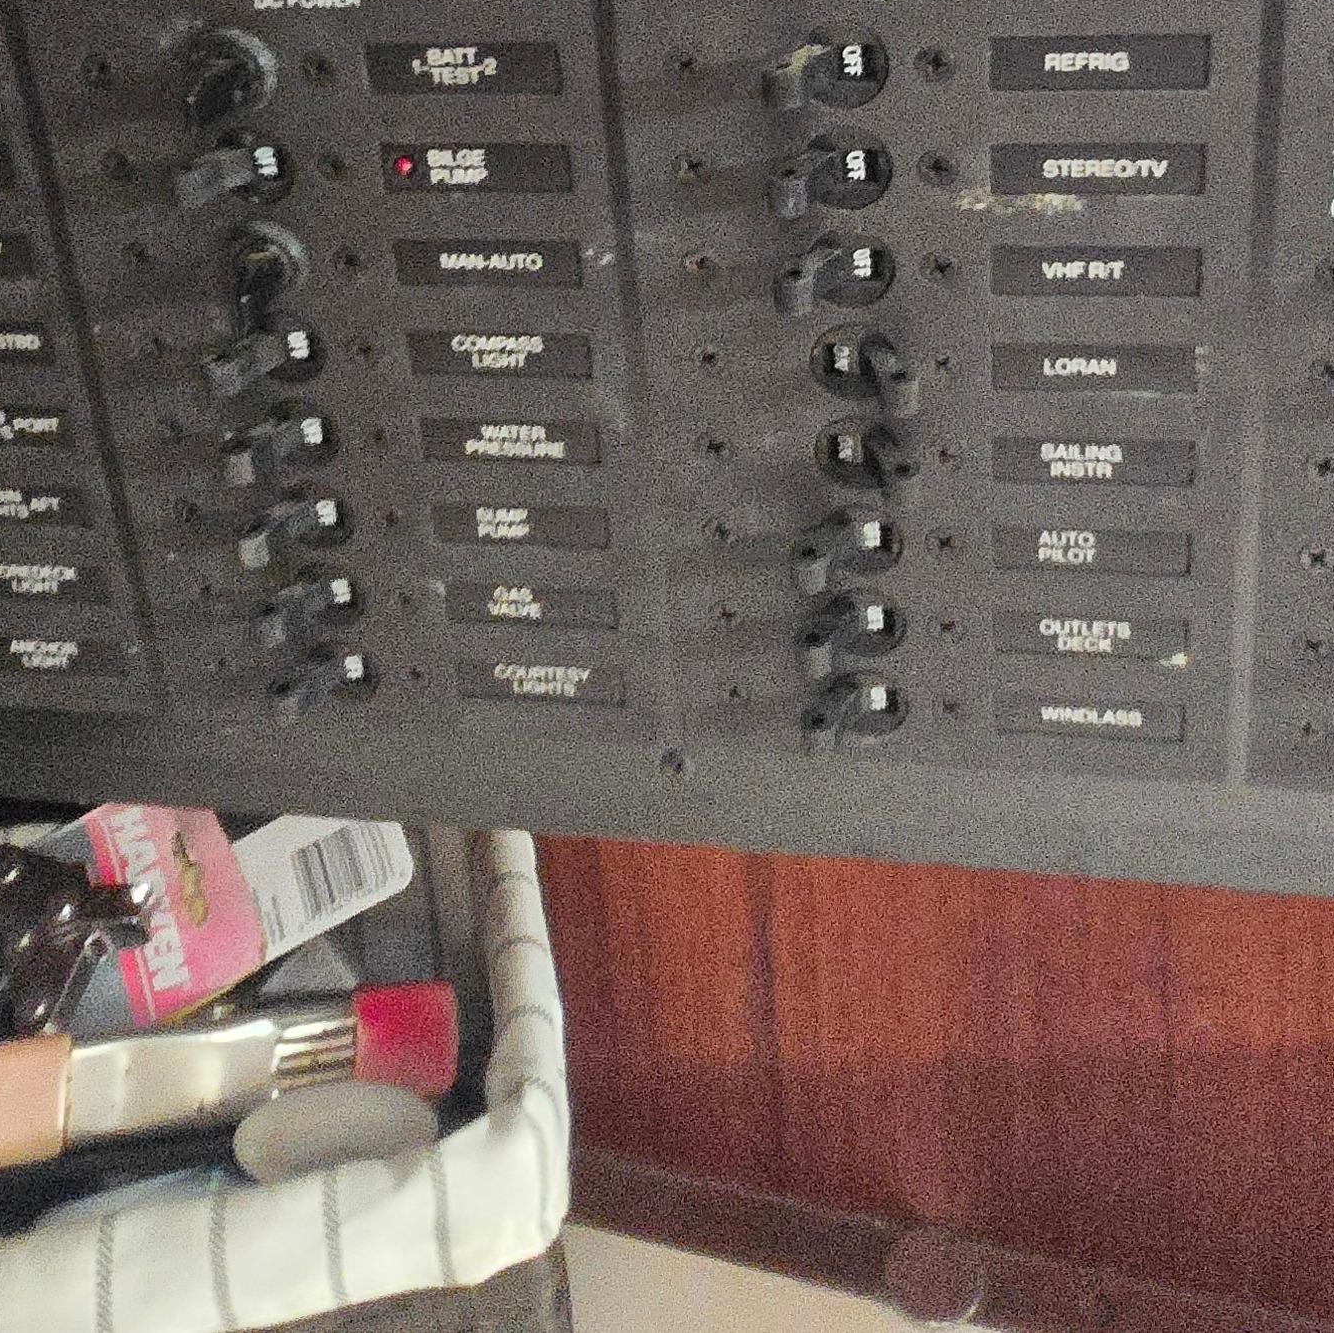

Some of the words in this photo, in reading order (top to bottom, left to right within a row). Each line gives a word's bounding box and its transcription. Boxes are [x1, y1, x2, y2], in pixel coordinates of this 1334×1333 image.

[426, 47, 478, 67] BATT
[843, 45, 862, 75] OFF
[1044, 51, 1131, 73] REFRIG
[430, 65, 480, 85] TEST
[426, 148, 486, 168] BILGE
[847, 151, 865, 179] OFF
[429, 166, 489, 186] PUMP
[1042, 158, 1169, 180] STEREO/TV
[853, 249, 871, 277] OFF
[1042, 260, 1086, 280] VHF
[451, 335, 544, 354] COMPASS
[471, 351, 527, 369] LIGHT
[1043, 357, 1117, 377] LORAN
[480, 424, 546, 443] WATER
[1040, 442, 1124, 463] SAILING
[1050, 461, 1114, 480] INSTR
[1039, 530, 1096, 549] AUTO
[1038, 546, 1096, 565] PILOT
[1039, 619, 1131, 641] OUTLETS
[1057, 635, 1113, 654] DECK
[1041, 706, 1143, 727] WINDLASS
